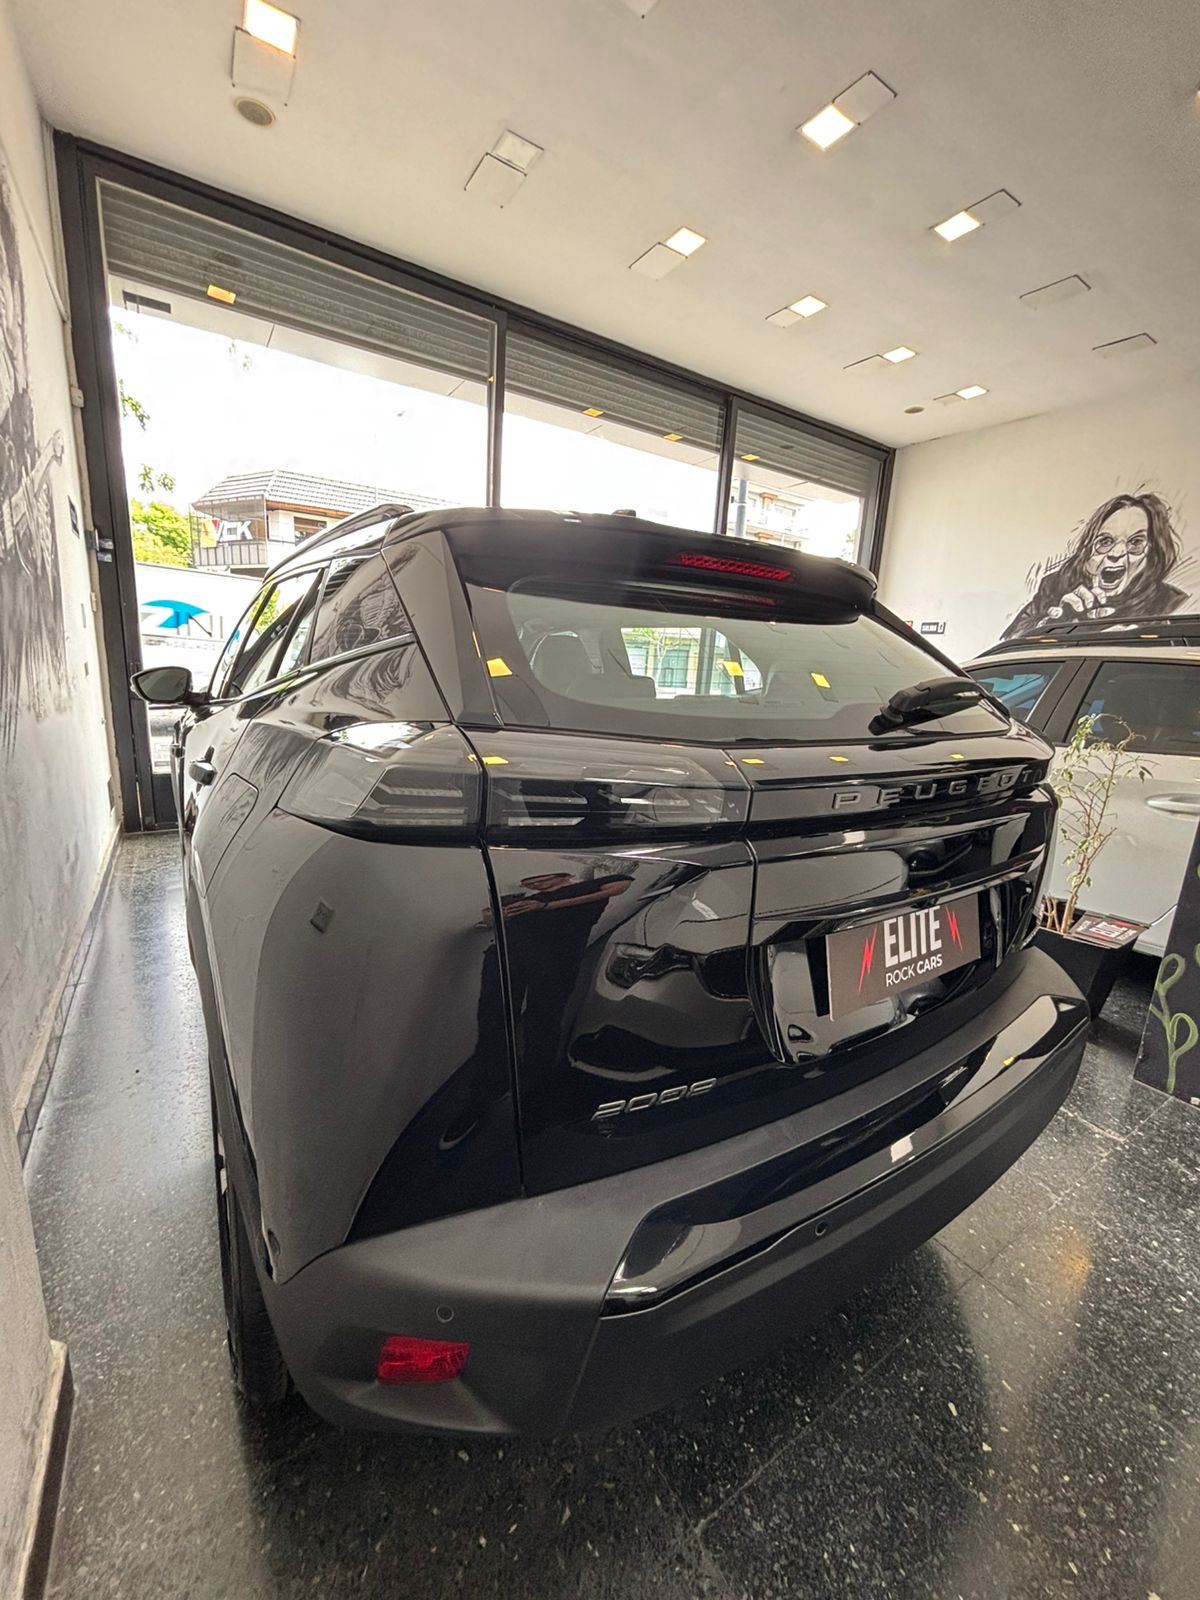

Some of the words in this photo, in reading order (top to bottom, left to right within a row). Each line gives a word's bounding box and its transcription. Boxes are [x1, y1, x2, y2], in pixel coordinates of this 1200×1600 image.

[832, 769, 1034, 810] PEUGEOT
[883, 905, 942, 968] ELITE
[885, 964, 916, 988] ROCK
[916, 953, 943, 974] CARS
[590, 1077, 718, 1121] 2008
